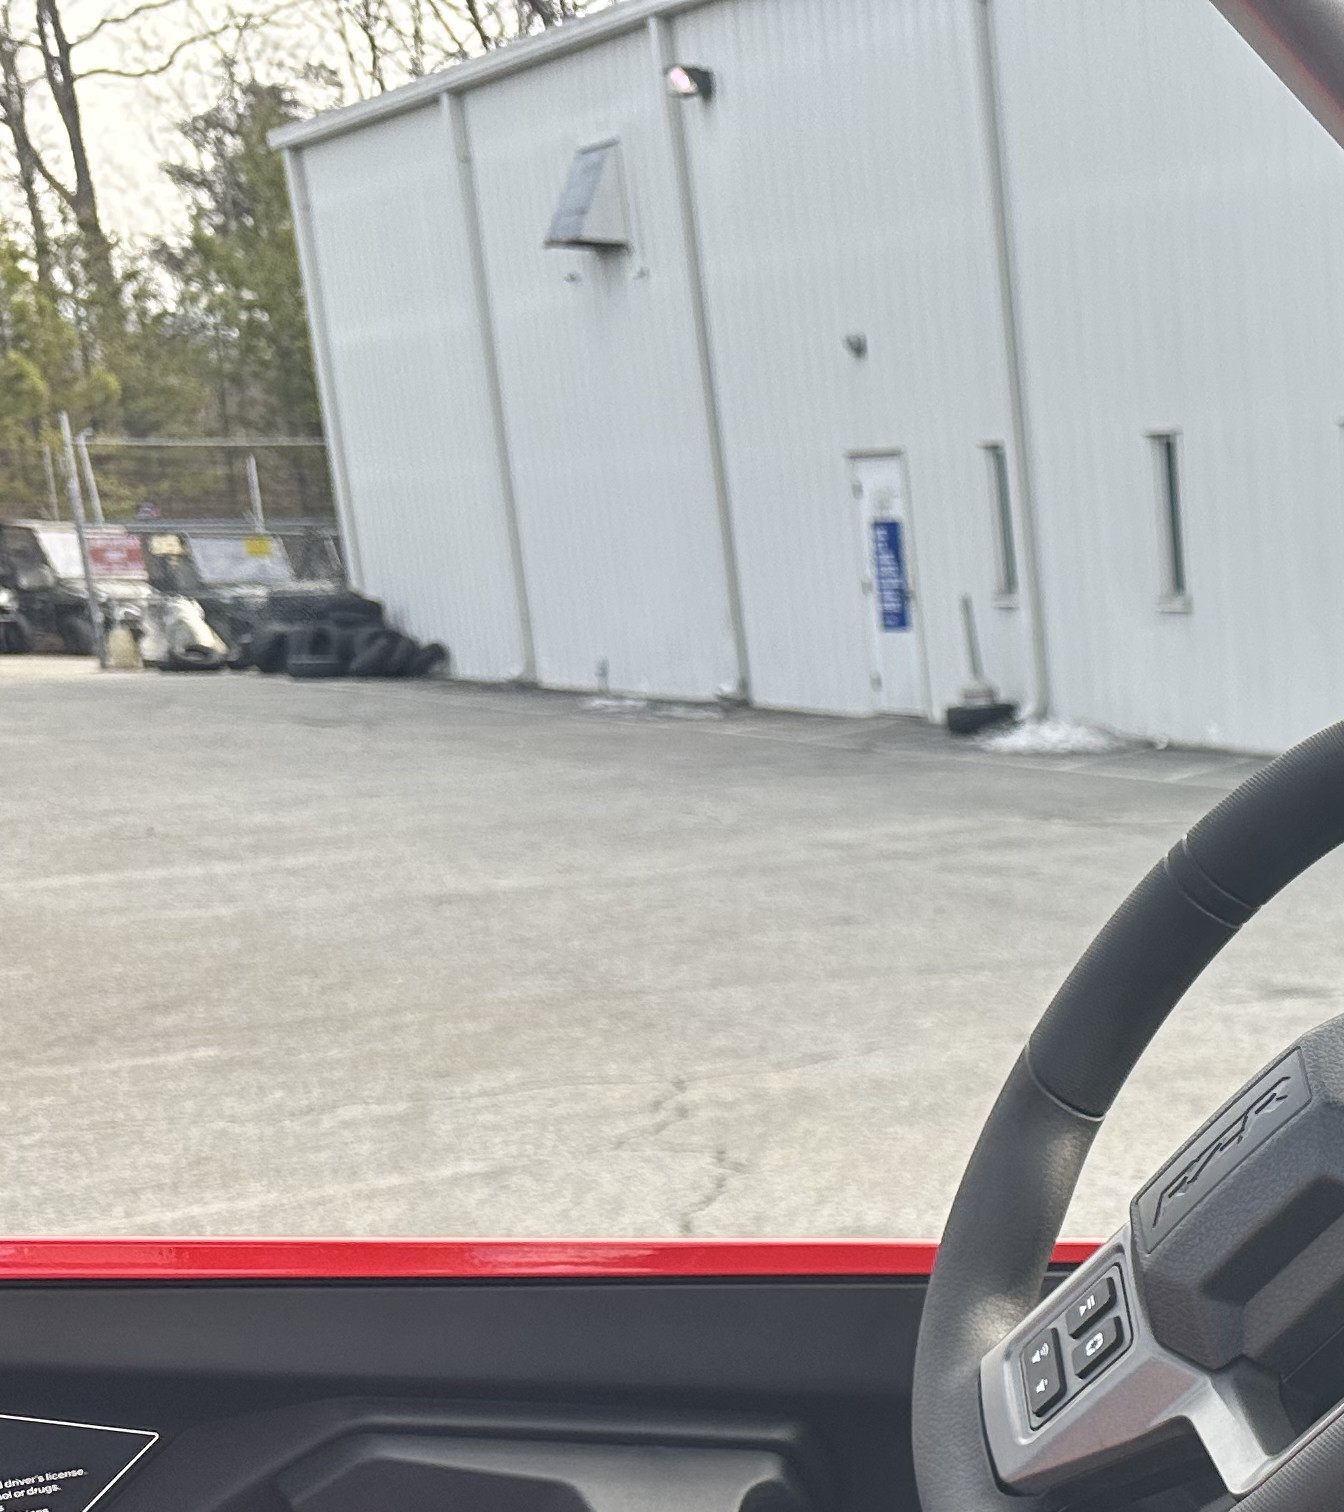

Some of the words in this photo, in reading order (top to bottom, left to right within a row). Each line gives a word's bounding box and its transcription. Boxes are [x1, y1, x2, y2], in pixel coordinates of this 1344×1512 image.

[4, 1474, 45, 1488] driver's
[45, 1468, 88, 1481] license.
[13, 1490, 25, 1499] or
[26, 1484, 62, 1495] drugs.
